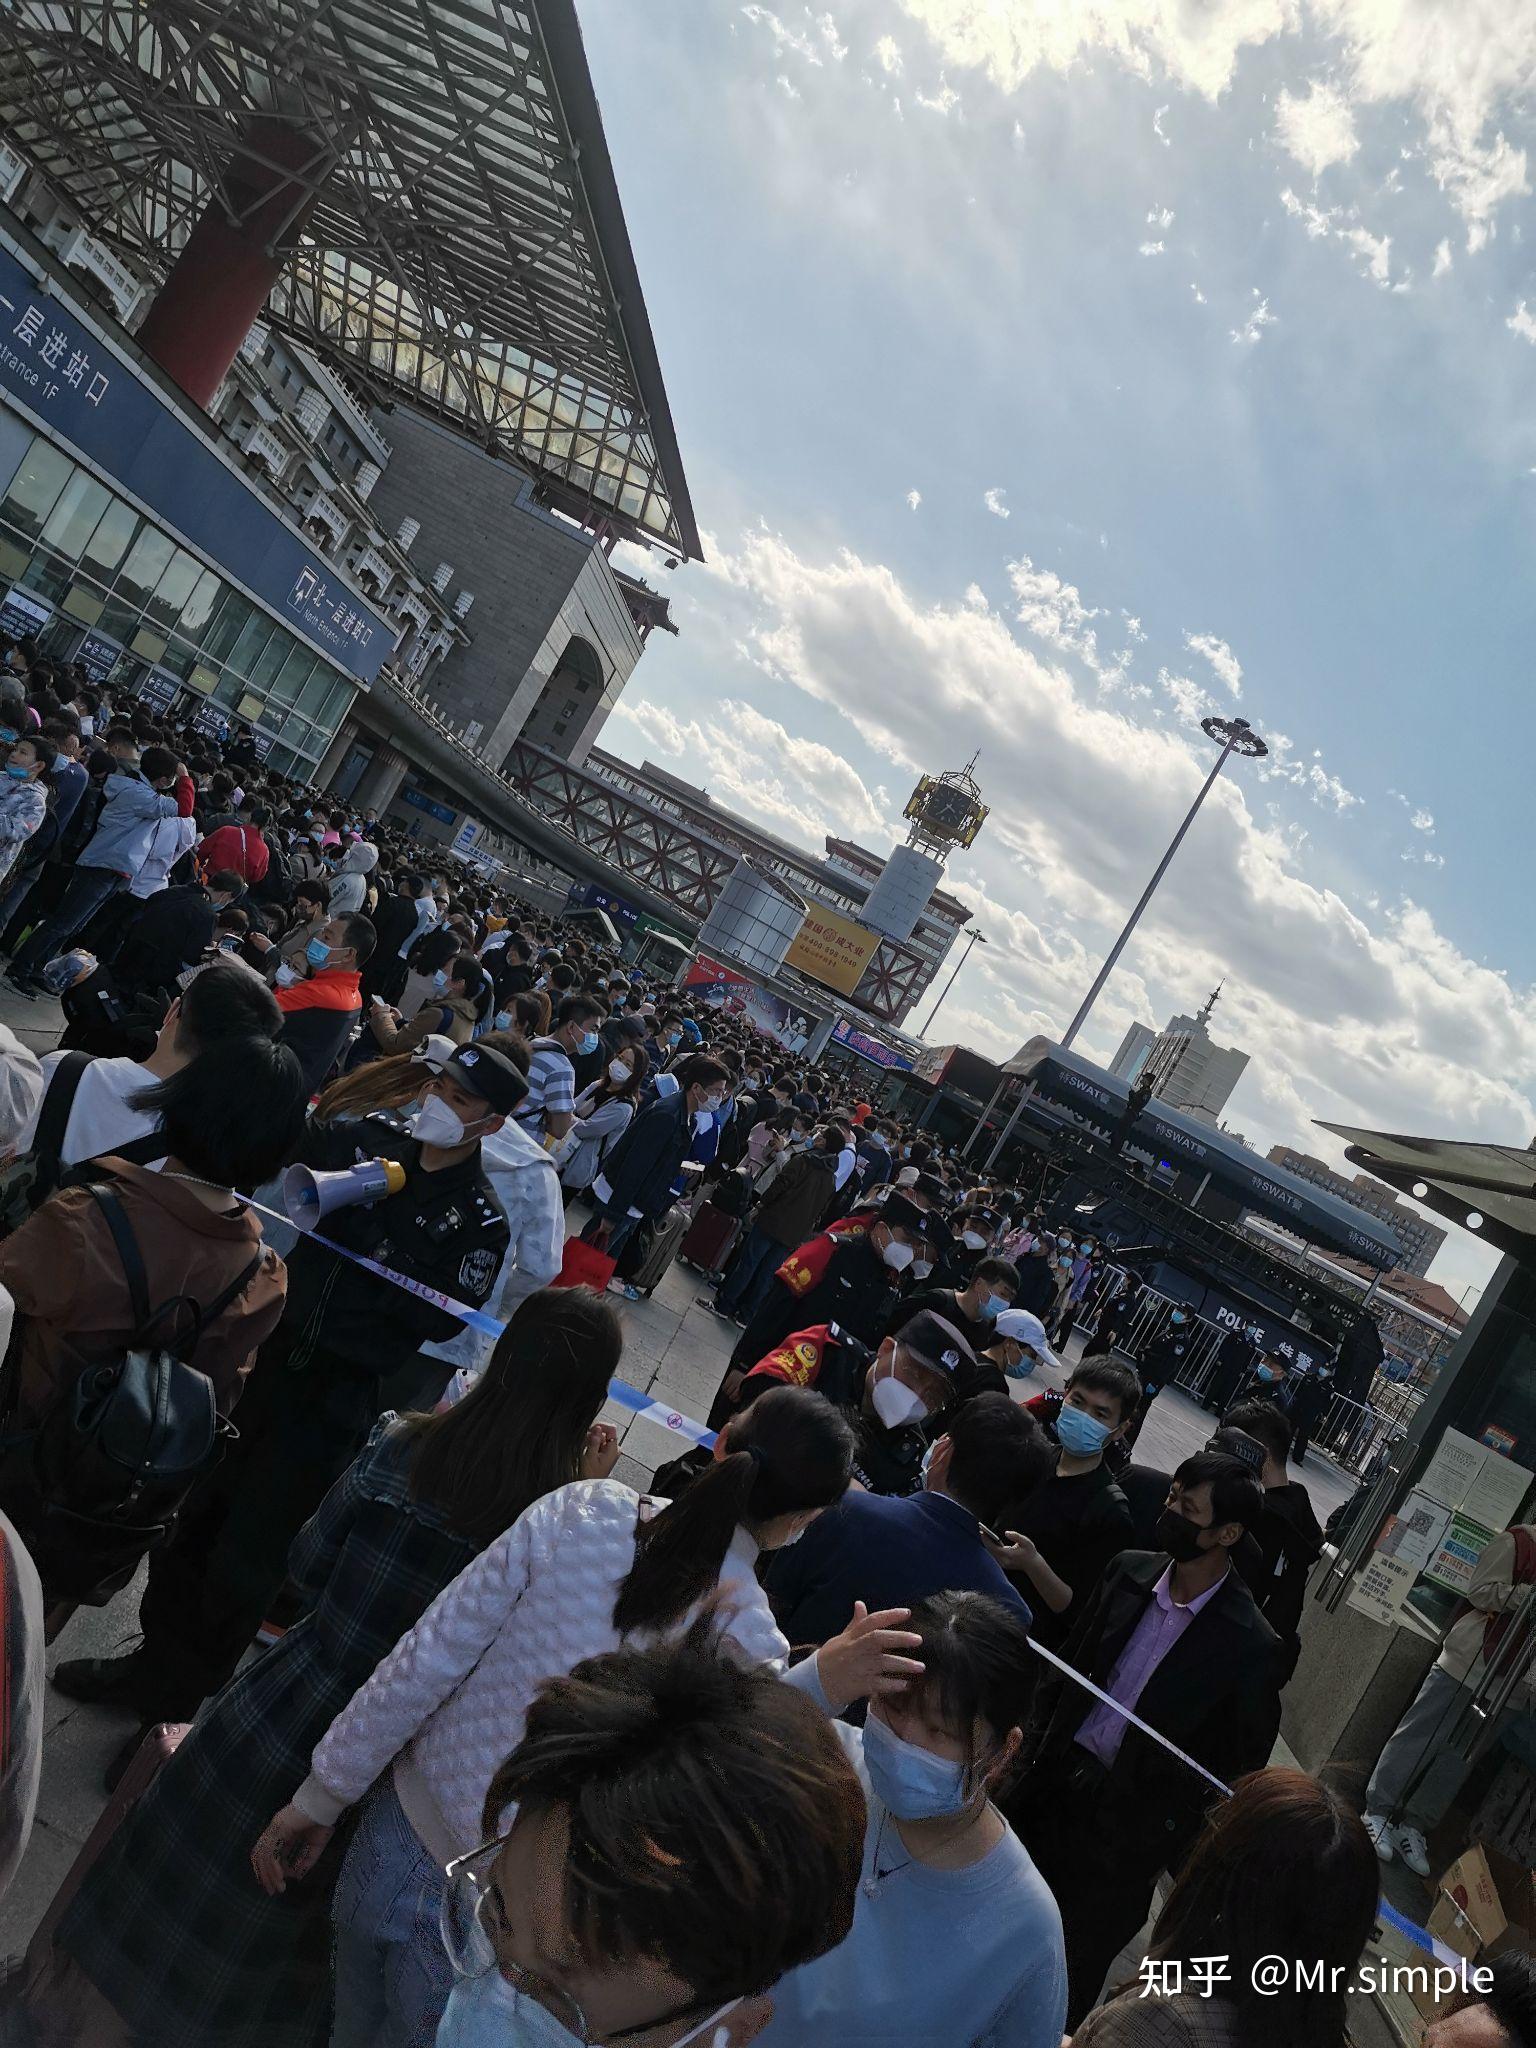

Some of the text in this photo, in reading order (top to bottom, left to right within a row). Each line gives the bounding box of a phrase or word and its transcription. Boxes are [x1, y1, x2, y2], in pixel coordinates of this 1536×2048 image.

[1, 294, 111, 407] 一层进站口
[41, 380, 60, 402] 1F
[303, 609, 318, 626] North
[317, 620, 340, 645] Entrance
[312, 583, 373, 648] 北一层进站口
[1216, 1306, 1314, 1372] POLIE 特警
